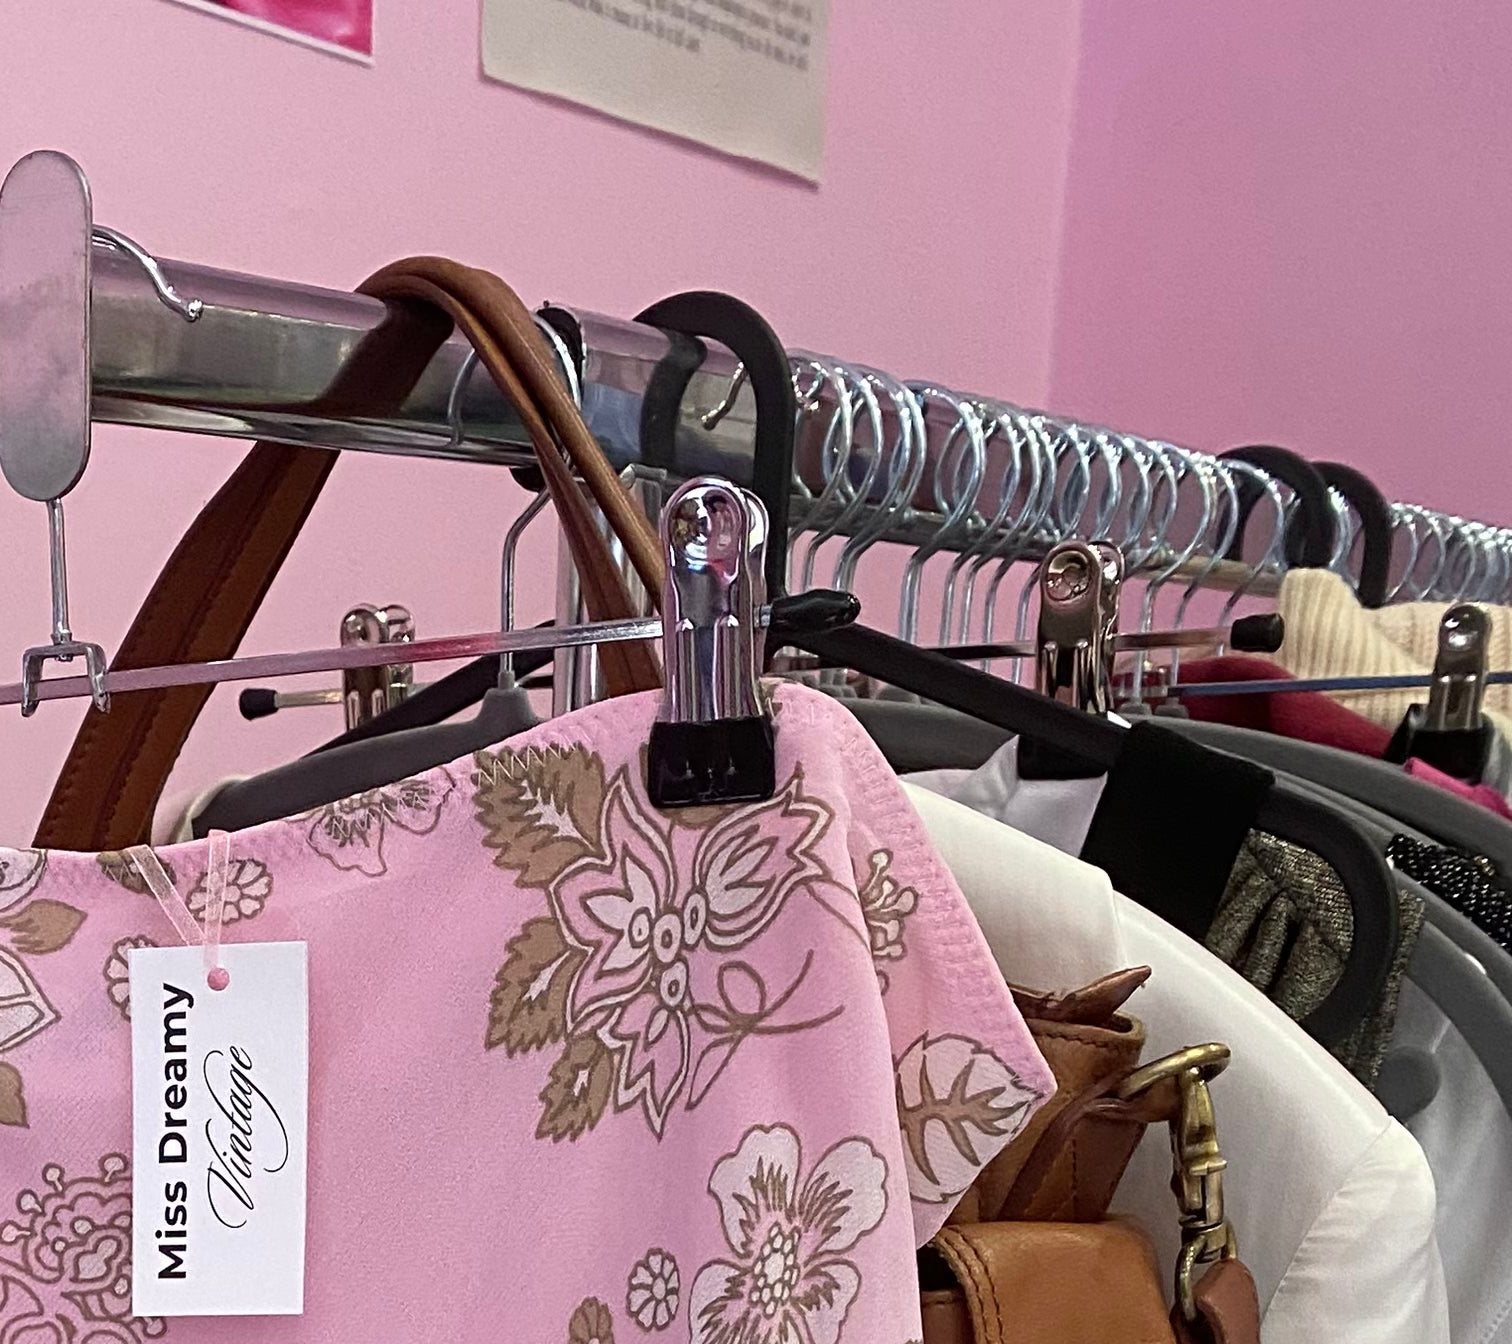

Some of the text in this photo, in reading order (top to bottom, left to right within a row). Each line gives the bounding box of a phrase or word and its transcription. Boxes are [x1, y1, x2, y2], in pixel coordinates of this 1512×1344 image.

[154, 983, 194, 1280] Miss Dreamy
[203, 1045, 289, 1229] Vintage
